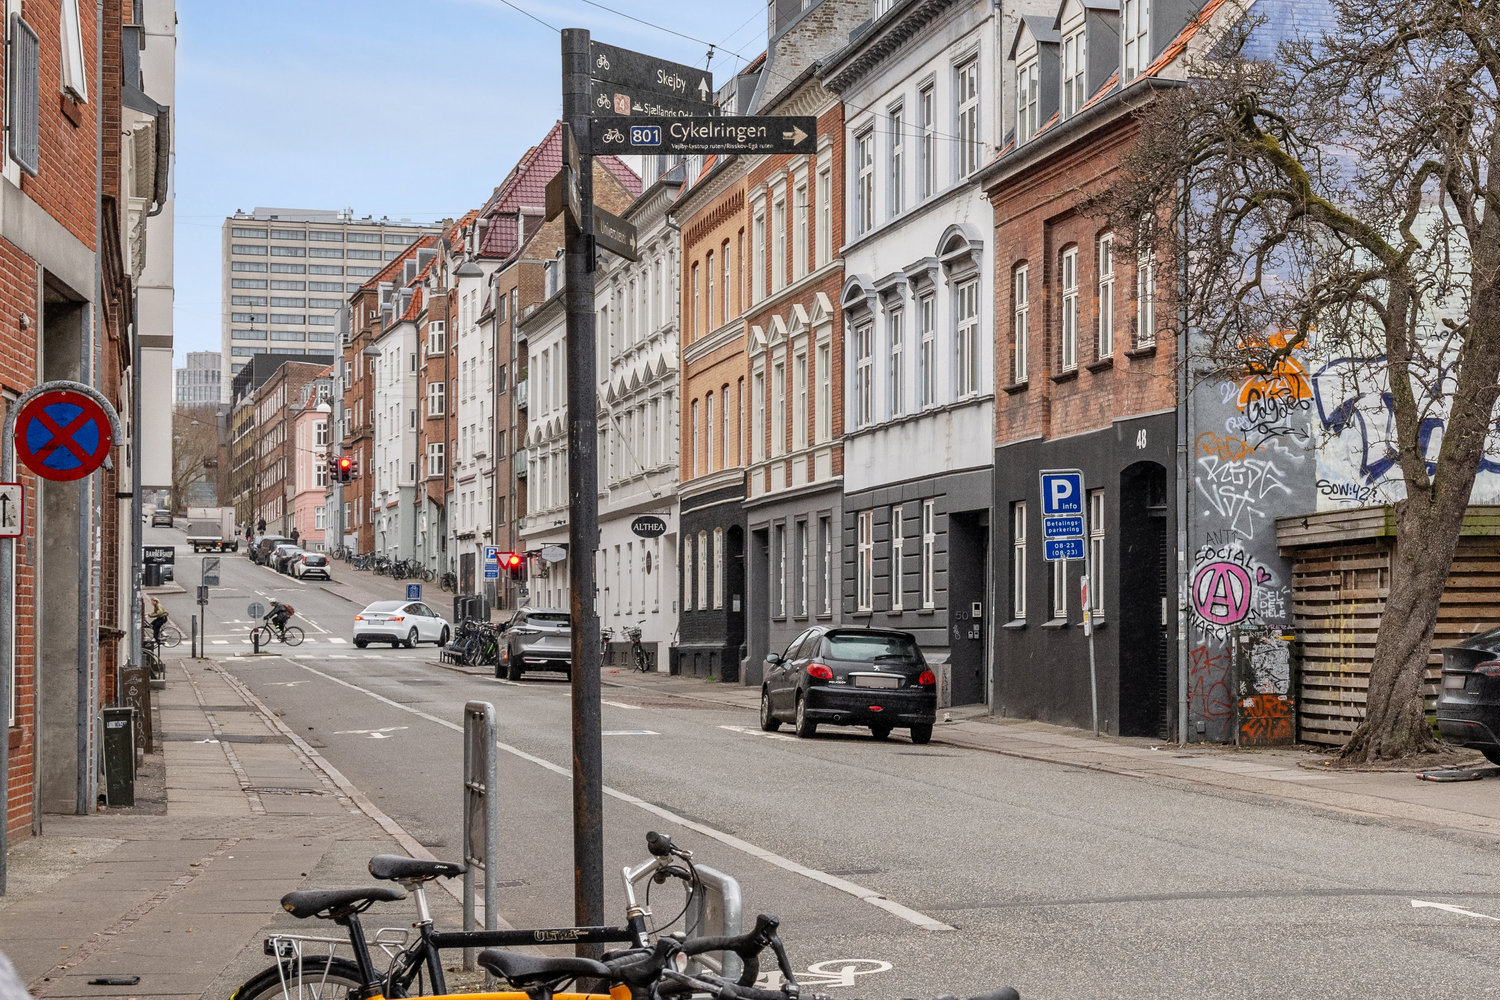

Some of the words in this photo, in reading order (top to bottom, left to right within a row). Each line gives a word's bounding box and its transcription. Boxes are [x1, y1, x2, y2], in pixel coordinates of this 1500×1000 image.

[656, 69, 687, 93] Skejby
[617, 96, 626, 111] 4
[644, 103, 677, 117] Sjællands
[678, 109, 694, 117] Odd
[633, 129, 661, 144] 801
[669, 122, 767, 143] Cykelringen
[1136, 429, 1147, 449] 48
[1051, 479, 1073, 510] P
[1062, 502, 1078, 510] info
[633, 523, 664, 532] ALTHEA
[1046, 520, 1081, 528] Betalings-
[1194, 548, 1254, 571] SOCIAL
[1260, 601, 1284, 610] DET
[955, 610, 969, 621] 50
[1260, 609, 1286, 619] HELE
